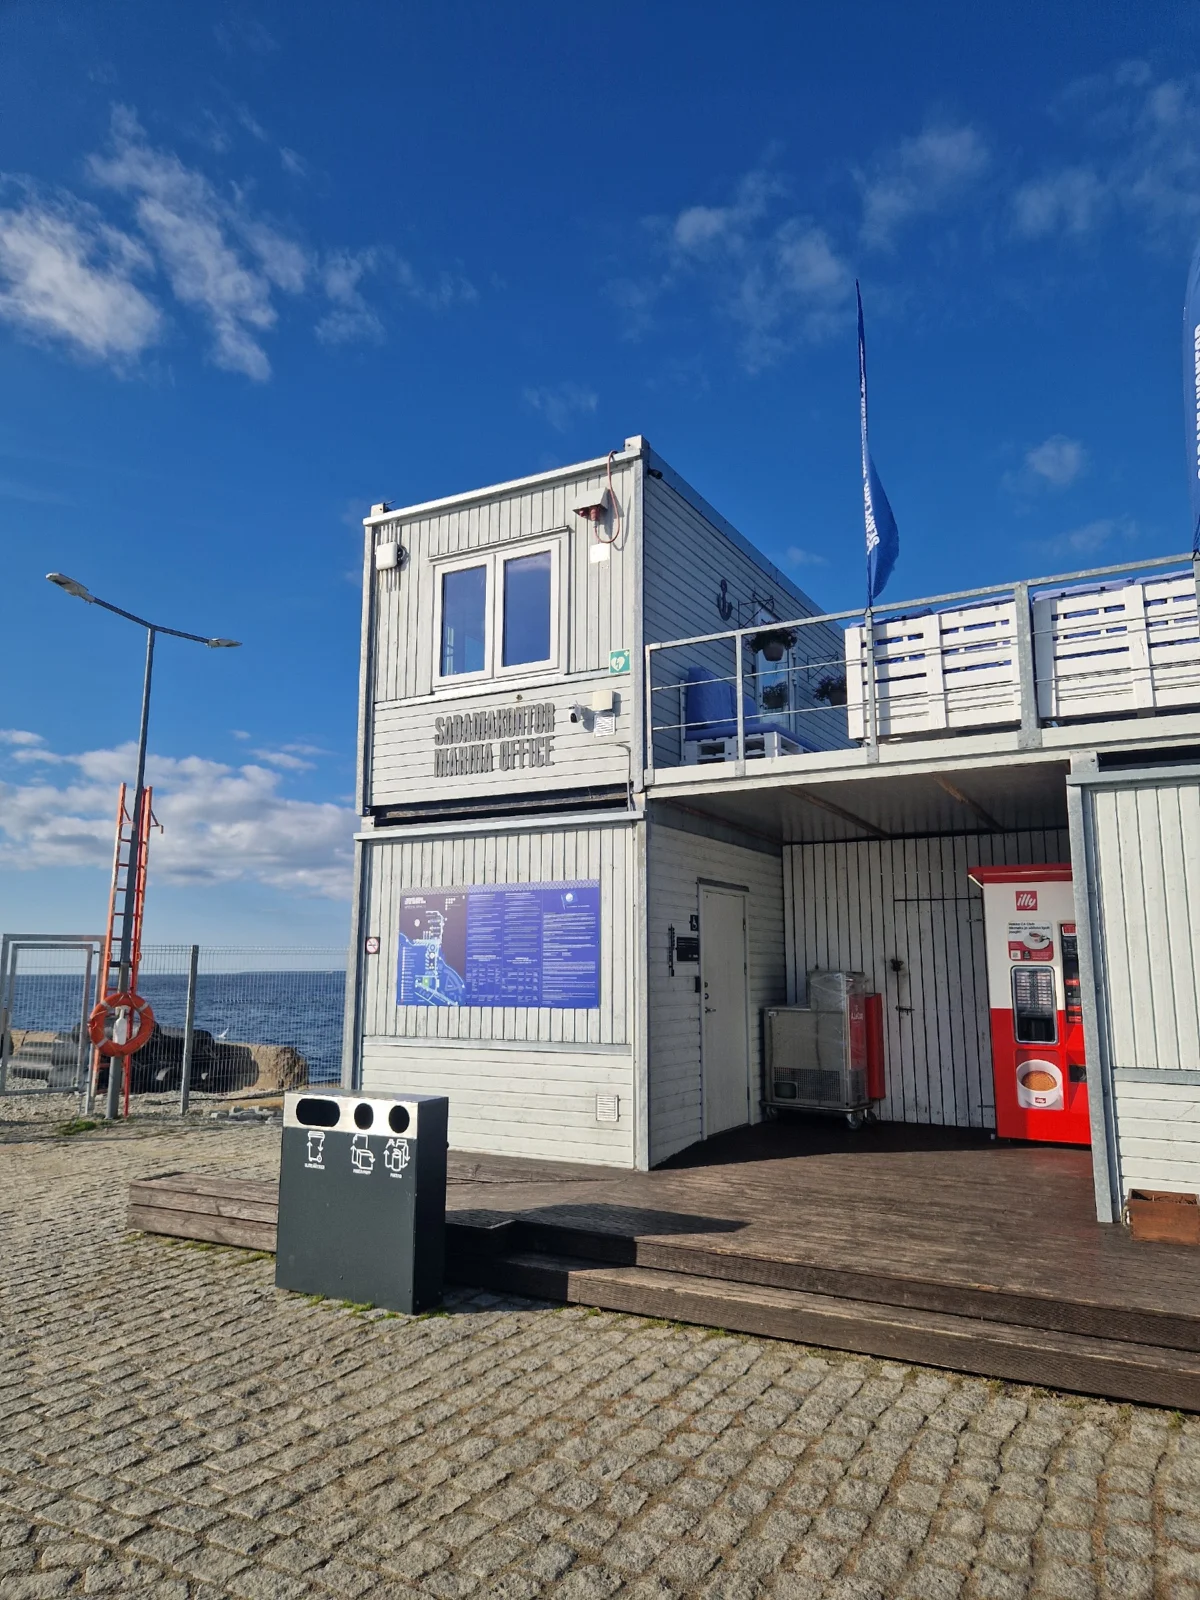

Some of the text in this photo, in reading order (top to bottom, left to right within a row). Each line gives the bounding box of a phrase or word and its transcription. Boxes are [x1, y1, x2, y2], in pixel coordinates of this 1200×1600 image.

[434, 702, 555, 746] SADAMAKONTOR
[433, 735, 555, 778] MARINA OFFICE
[1017, 893, 1037, 909] illy
